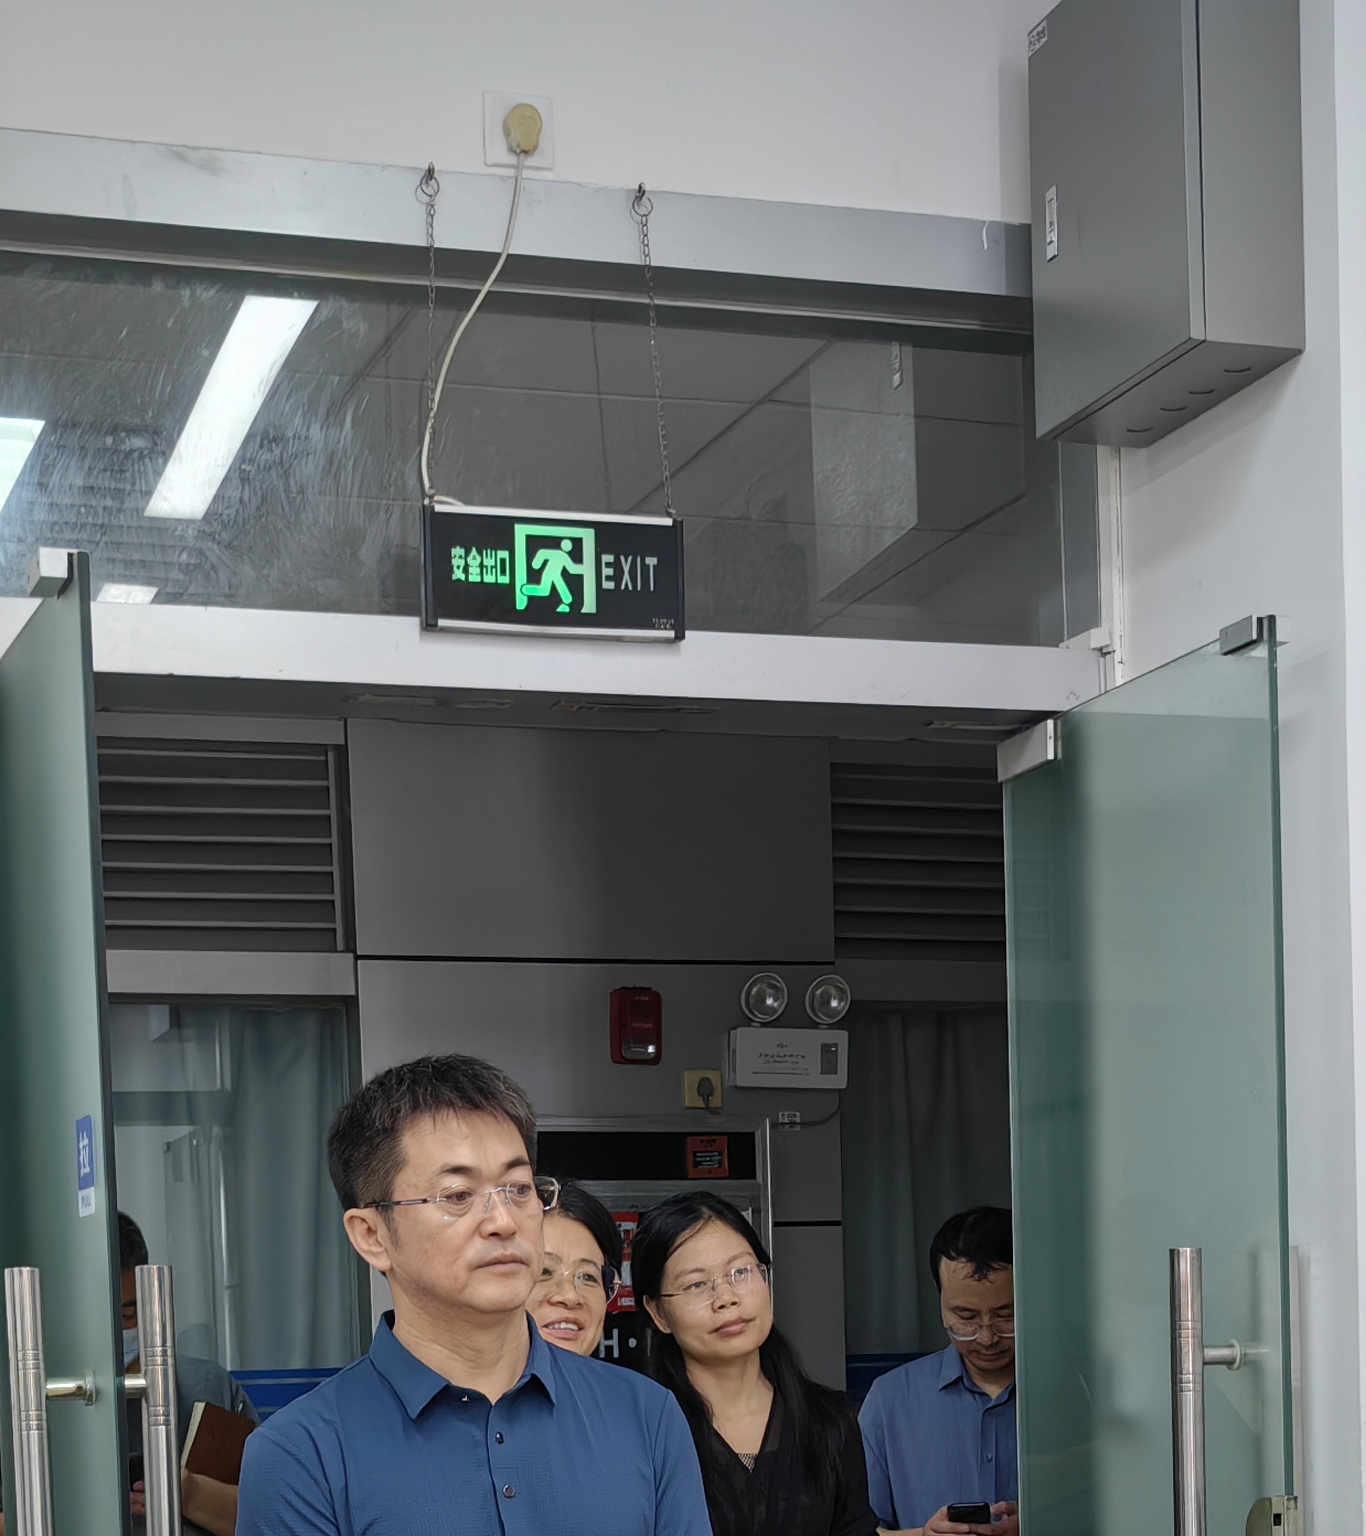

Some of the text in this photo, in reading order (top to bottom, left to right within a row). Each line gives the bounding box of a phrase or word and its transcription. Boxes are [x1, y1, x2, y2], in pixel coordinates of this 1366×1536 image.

[450, 545, 510, 584] 安全出口
[601, 554, 658, 591] EXIT
